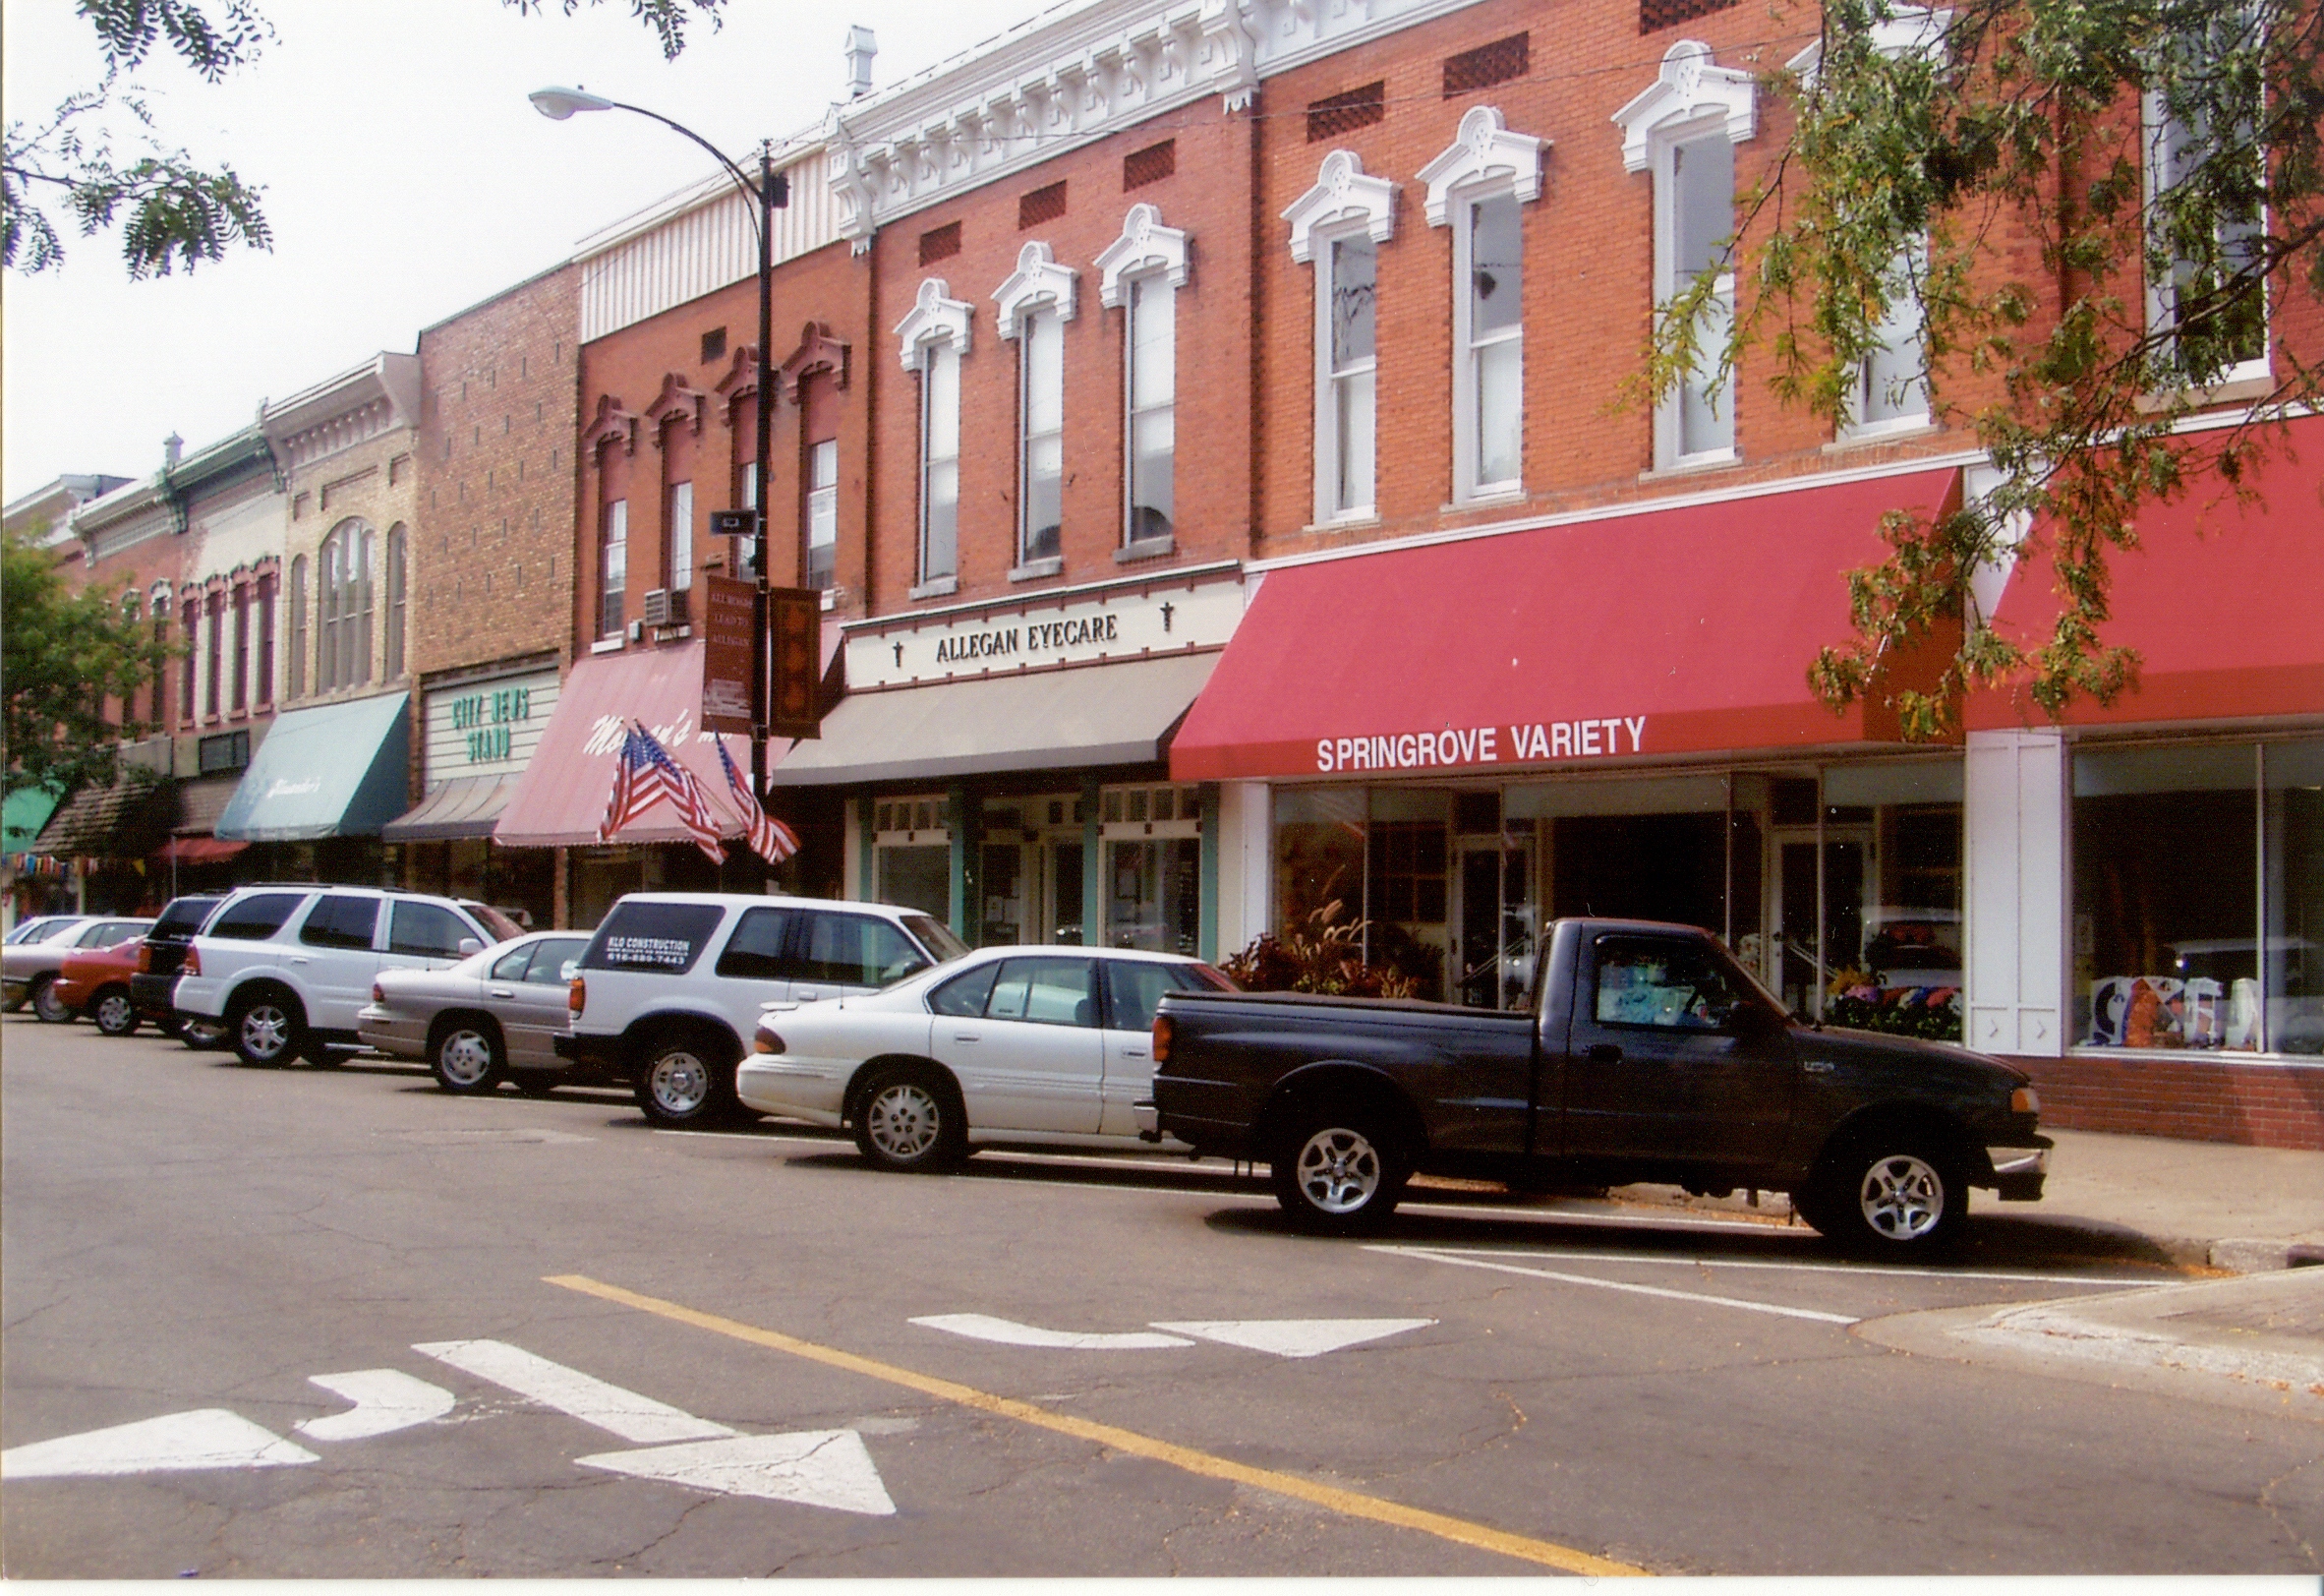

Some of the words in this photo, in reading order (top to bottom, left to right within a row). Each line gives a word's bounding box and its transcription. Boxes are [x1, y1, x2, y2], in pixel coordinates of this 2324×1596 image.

[936, 627, 1019, 664] ALLEGAN
[1027, 614, 1119, 652] EYECARE
[452, 693, 484, 730] CITY
[491, 686, 529, 723] NEWS
[467, 726, 510, 762] STAND
[1317, 728, 1497, 772] SPRINGROVE
[1511, 716, 1647, 760] VARIETY
[626, 937, 690, 952] CONSTRUCTION
